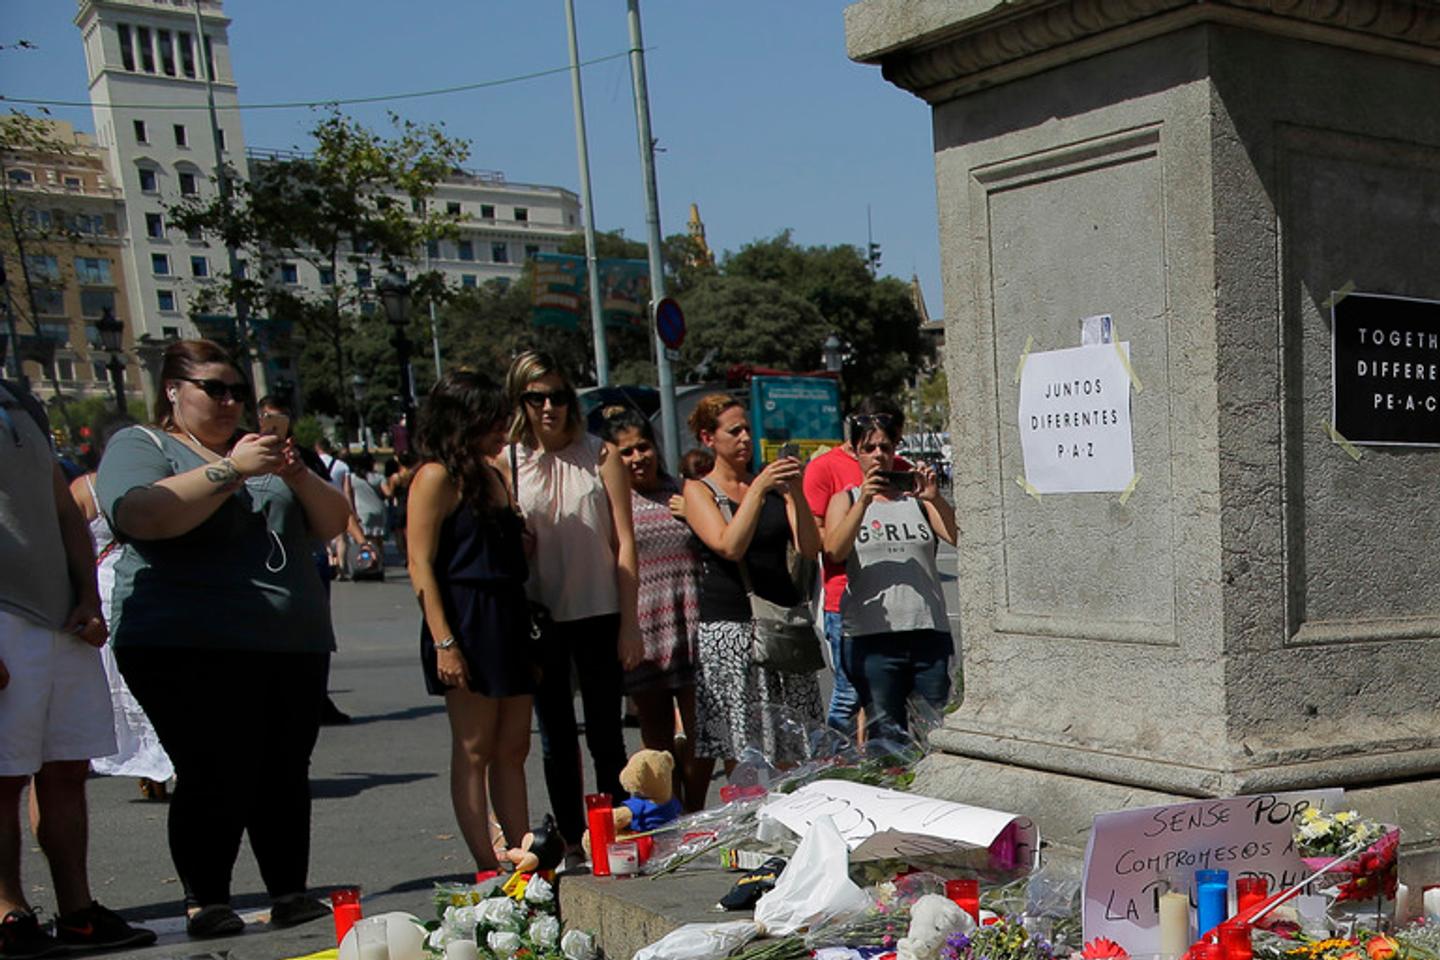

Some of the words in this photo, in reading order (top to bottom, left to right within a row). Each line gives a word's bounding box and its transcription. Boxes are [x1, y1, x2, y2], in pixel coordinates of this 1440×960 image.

[1045, 379, 1102, 399] JUNTOS
[1031, 409, 1118, 430] DIFERENTES
[1143, 803, 1230, 838] SENSE
[1115, 842, 1272, 876] COMPROMESOS
[1105, 889, 1139, 921] LA
